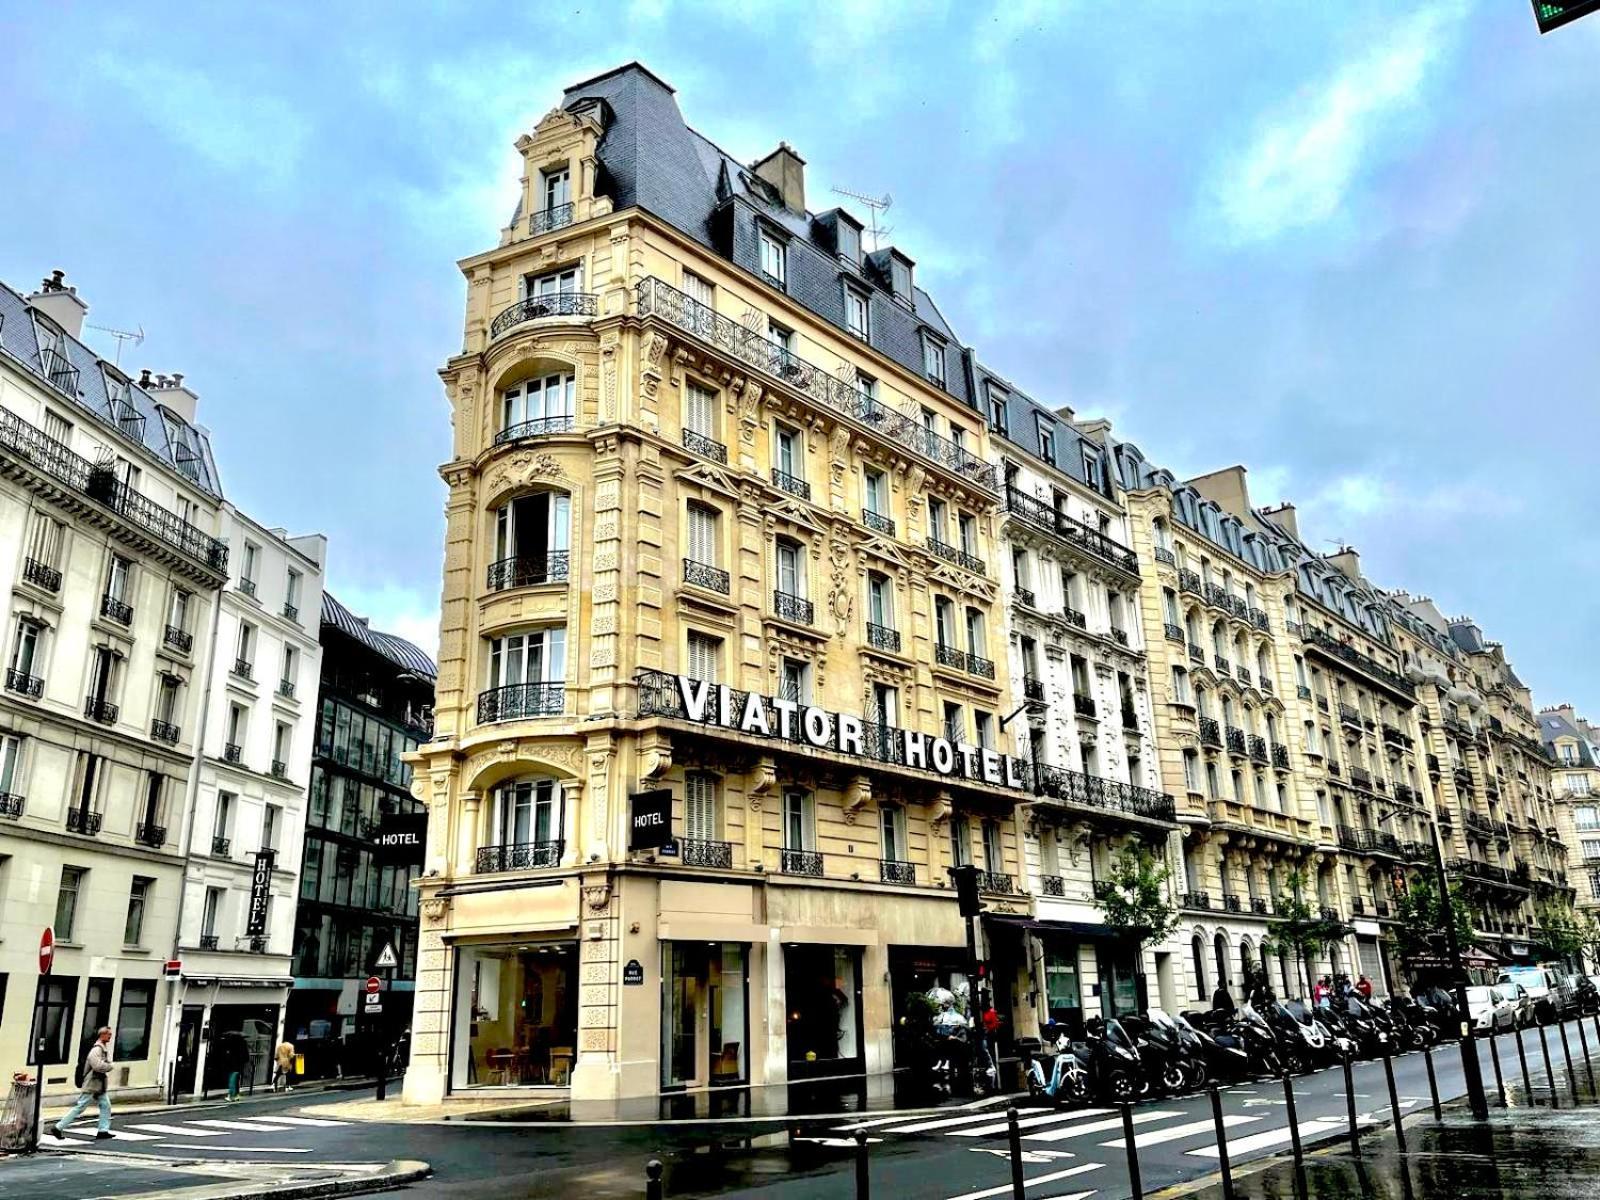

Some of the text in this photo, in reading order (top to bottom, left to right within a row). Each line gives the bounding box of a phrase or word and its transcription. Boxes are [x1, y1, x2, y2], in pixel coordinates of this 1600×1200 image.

[677, 675, 1022, 789] VIATOR HOTEL
[382, 833, 420, 845] HOTEL
[634, 812, 664, 828] HOTEL
[250, 858, 267, 924] HOTEL
